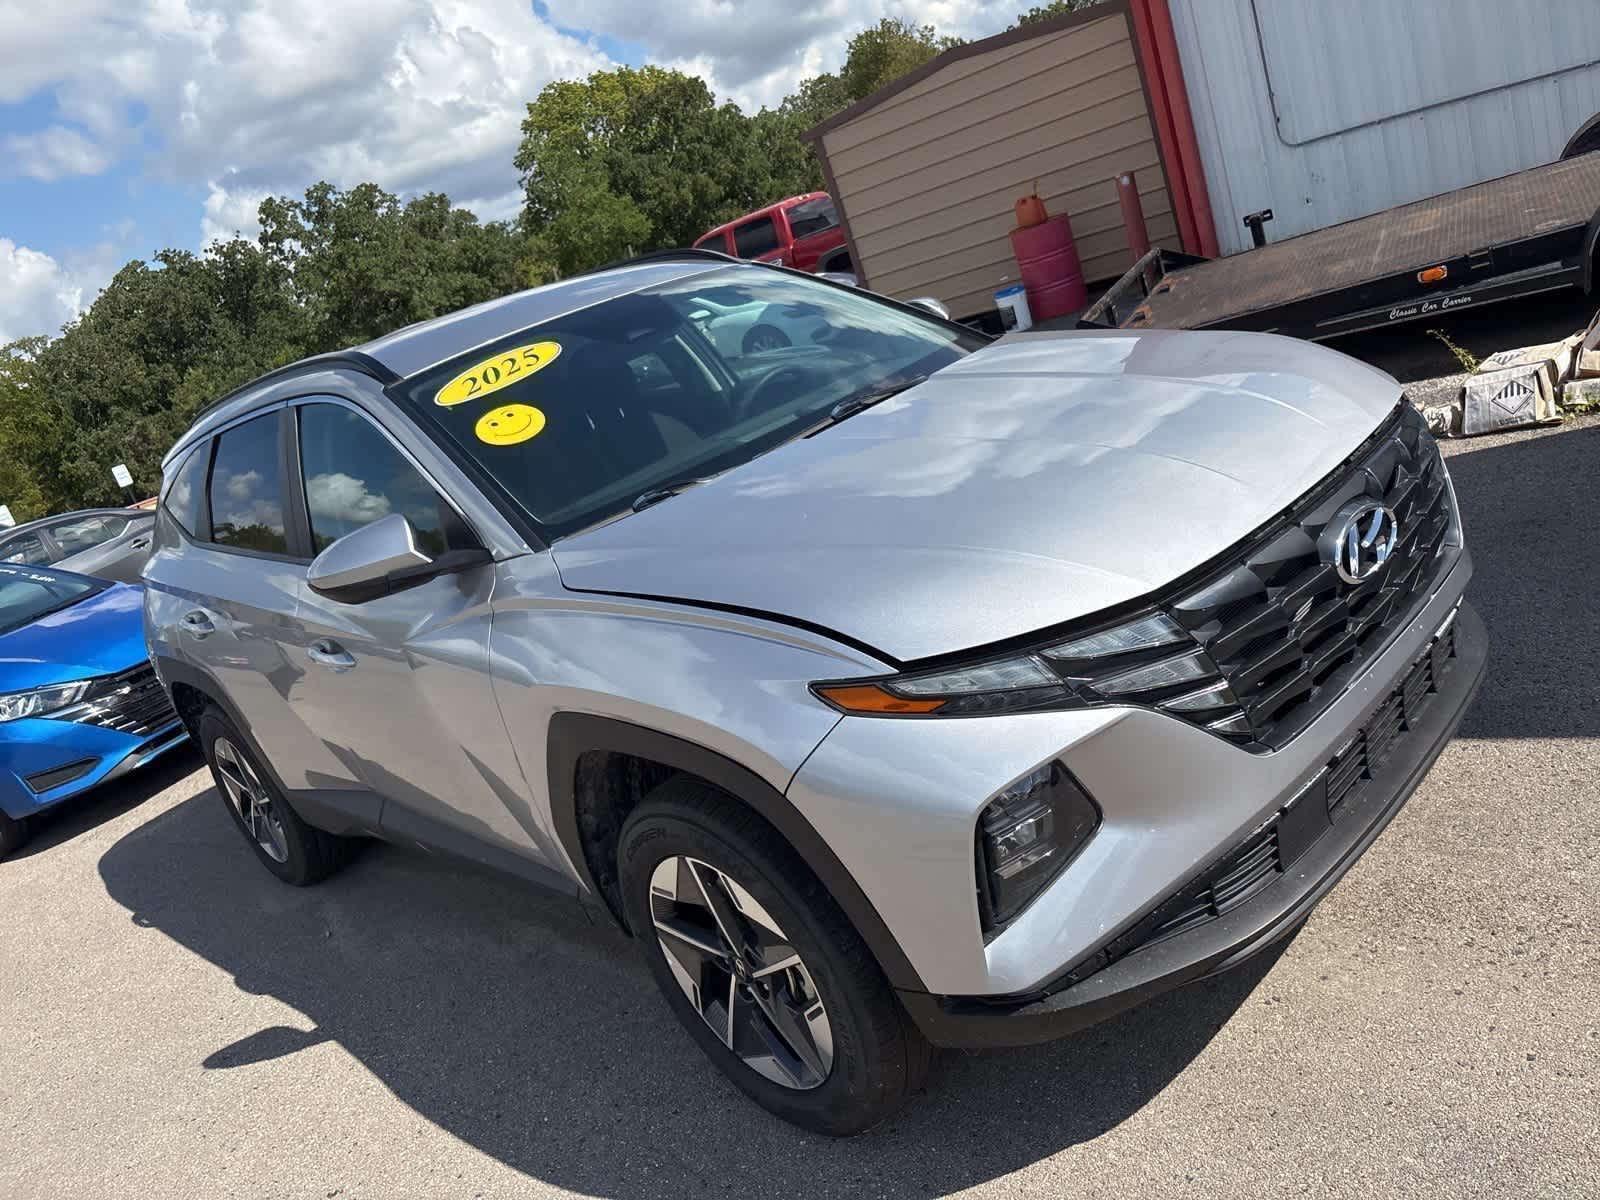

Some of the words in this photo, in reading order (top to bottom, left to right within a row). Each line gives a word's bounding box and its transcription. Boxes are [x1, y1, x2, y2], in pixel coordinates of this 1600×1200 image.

[1389, 308, 1417, 320] Classic
[1421, 302, 1437, 312] Car
[1442, 296, 1471, 308] Carrier
[462, 347, 540, 397] 2025
